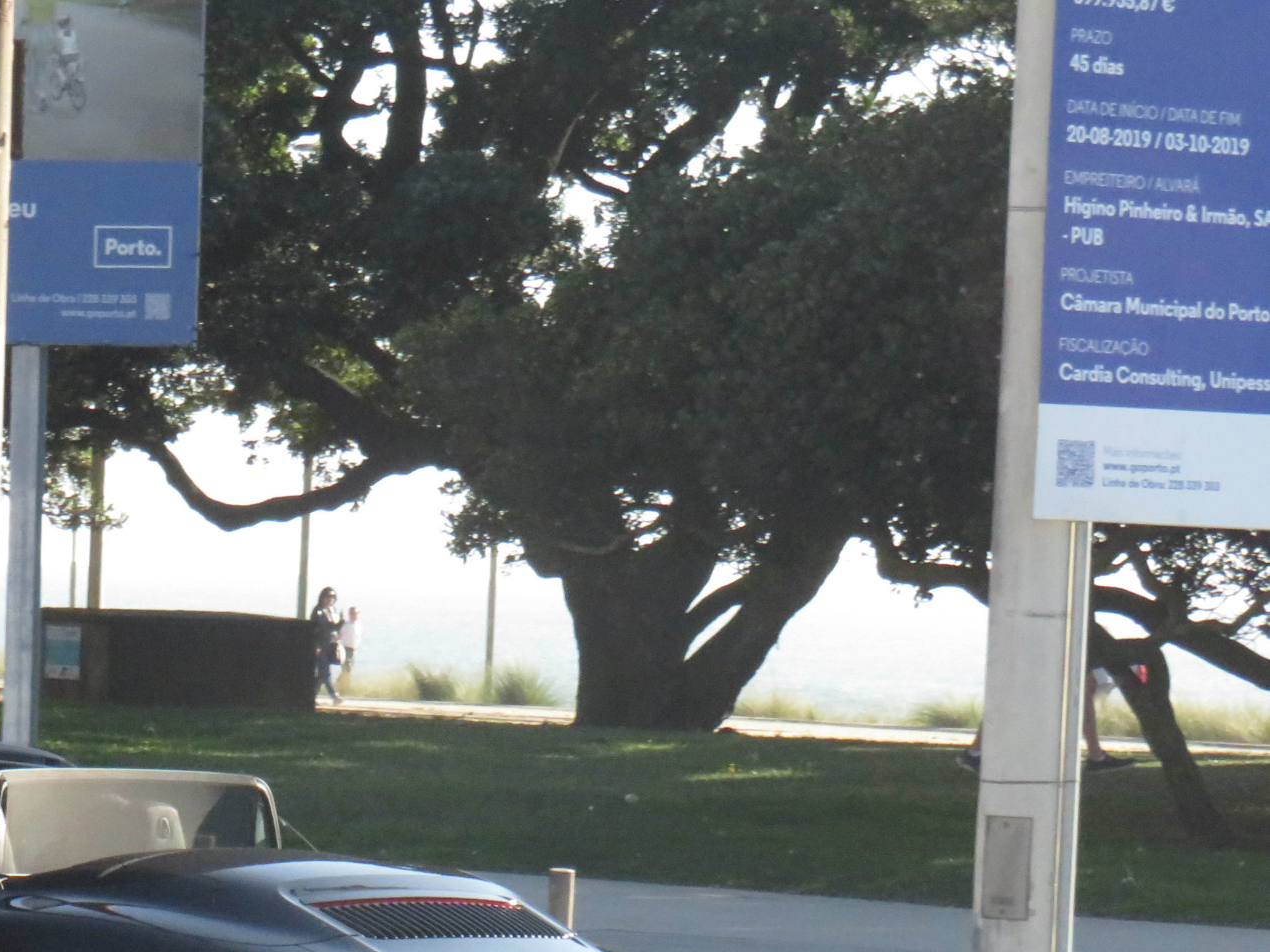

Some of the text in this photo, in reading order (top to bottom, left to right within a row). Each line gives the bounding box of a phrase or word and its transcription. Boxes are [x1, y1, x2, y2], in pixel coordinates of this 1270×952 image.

[1070, 28, 1113, 45] PRAZO
[1069, 54, 1124, 76] 45 dias
[1066, 99, 1098, 114] DATA
[1100, 102, 1117, 117] DE
[1119, 100, 1158, 120] INÍCIO
[1168, 107, 1198, 122] DATA
[1201, 109, 1218, 124] DE
[1219, 111, 1242, 126] FIM
[1066, 124, 1251, 156] 20-08-2019 / 03-10-2019
[1064, 170, 1146, 190] EMPREITEIRO
[1154, 175, 1200, 193] ALVARÁ
[1064, 196, 1116, 218] Higino
[1119, 199, 1183, 222] Pinheiro
[1186, 204, 1198, 222] &
[1202, 206, 1251, 228] Irmão,
[104, 238, 162, 256] Porto.
[1070, 226, 1104, 246] PUB
[1060, 267, 1134, 285] PROJETISTA
[1060, 292, 1270, 322] Câmara Municipal do Porto
[1059, 337, 1150, 356] FISCALIZAÇÃO
[1058, 362, 1113, 383] Cardia
[1116, 365, 1206, 392] Consulting,
